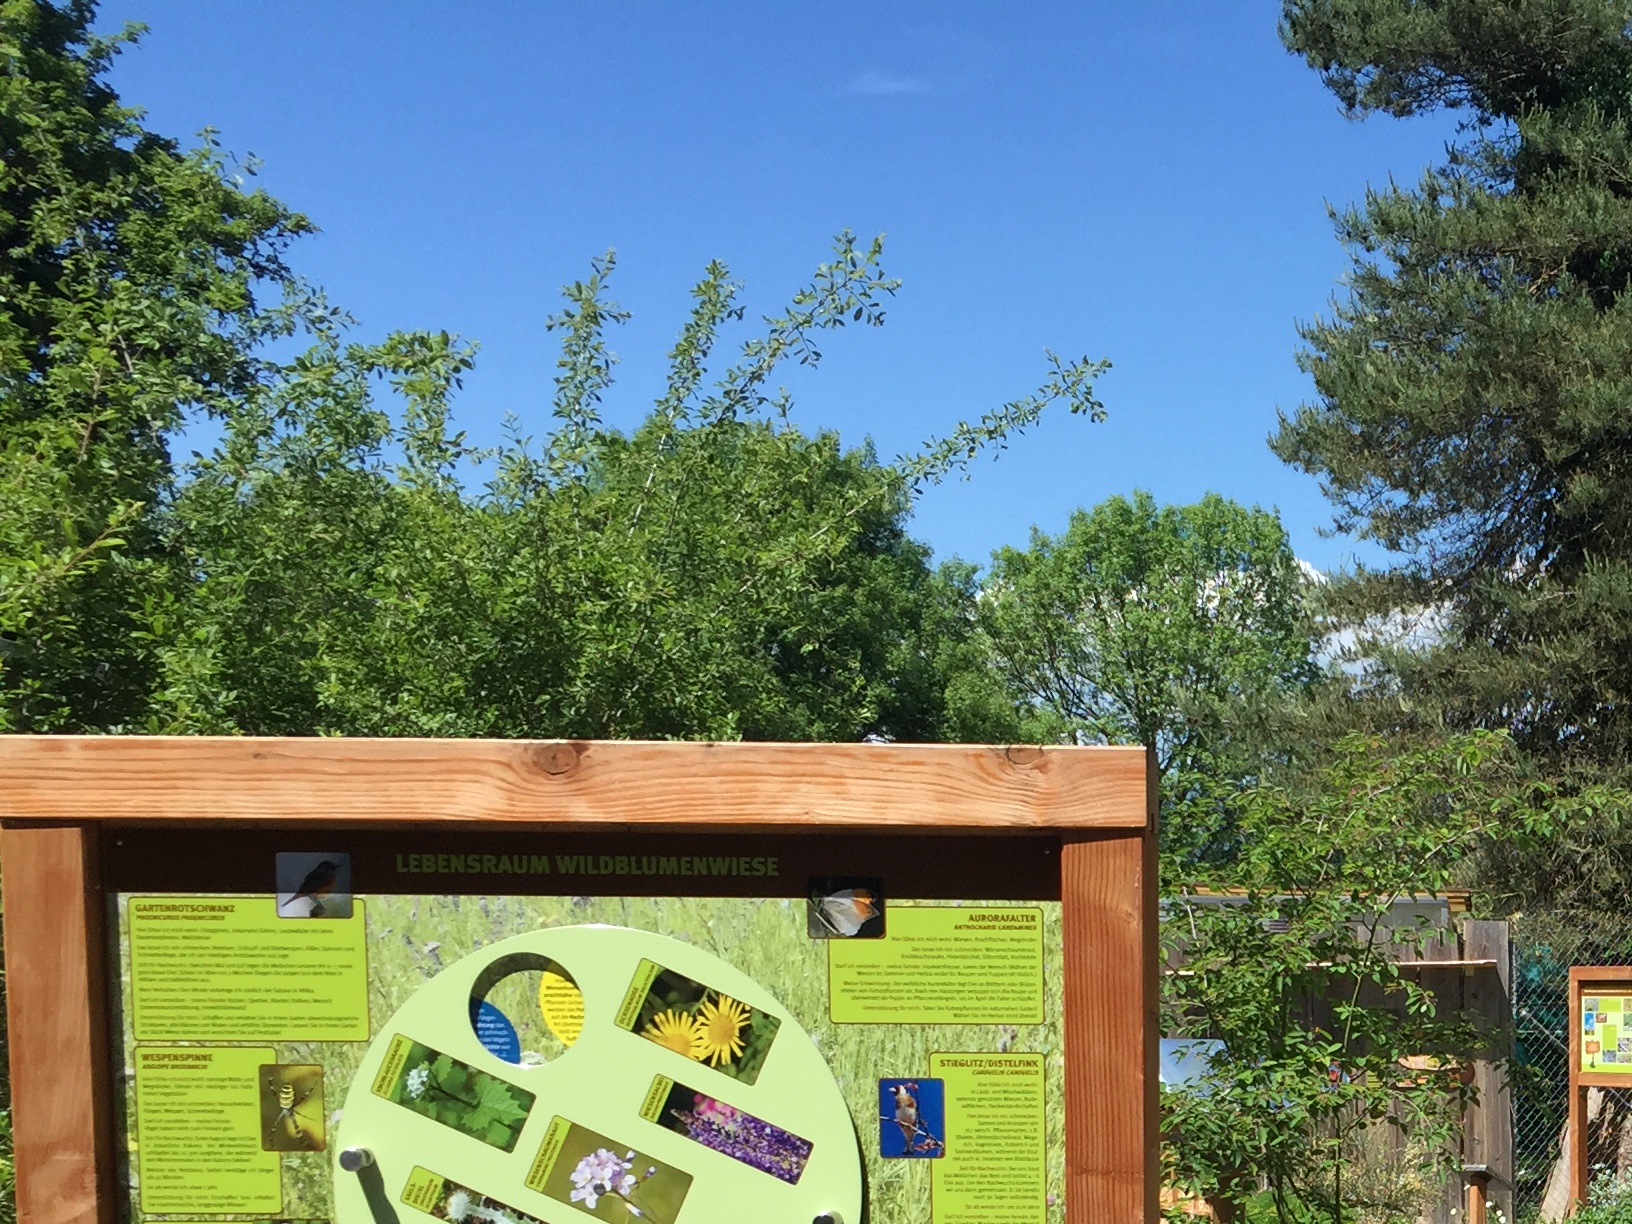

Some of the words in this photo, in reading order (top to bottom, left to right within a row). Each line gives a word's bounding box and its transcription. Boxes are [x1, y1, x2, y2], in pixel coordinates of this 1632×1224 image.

[395, 853, 551, 875] LEBENSRAUM
[556, 854, 780, 877] WILDBLUMENWIESE
[135, 904, 236, 914] GARTENROTSCHWANZ
[968, 914, 1037, 923] AURORAFALTER
[141, 1053, 213, 1062] WESPENSPINNE
[939, 1059, 1039, 1068] STIEGLITZ/DISTELFINK
